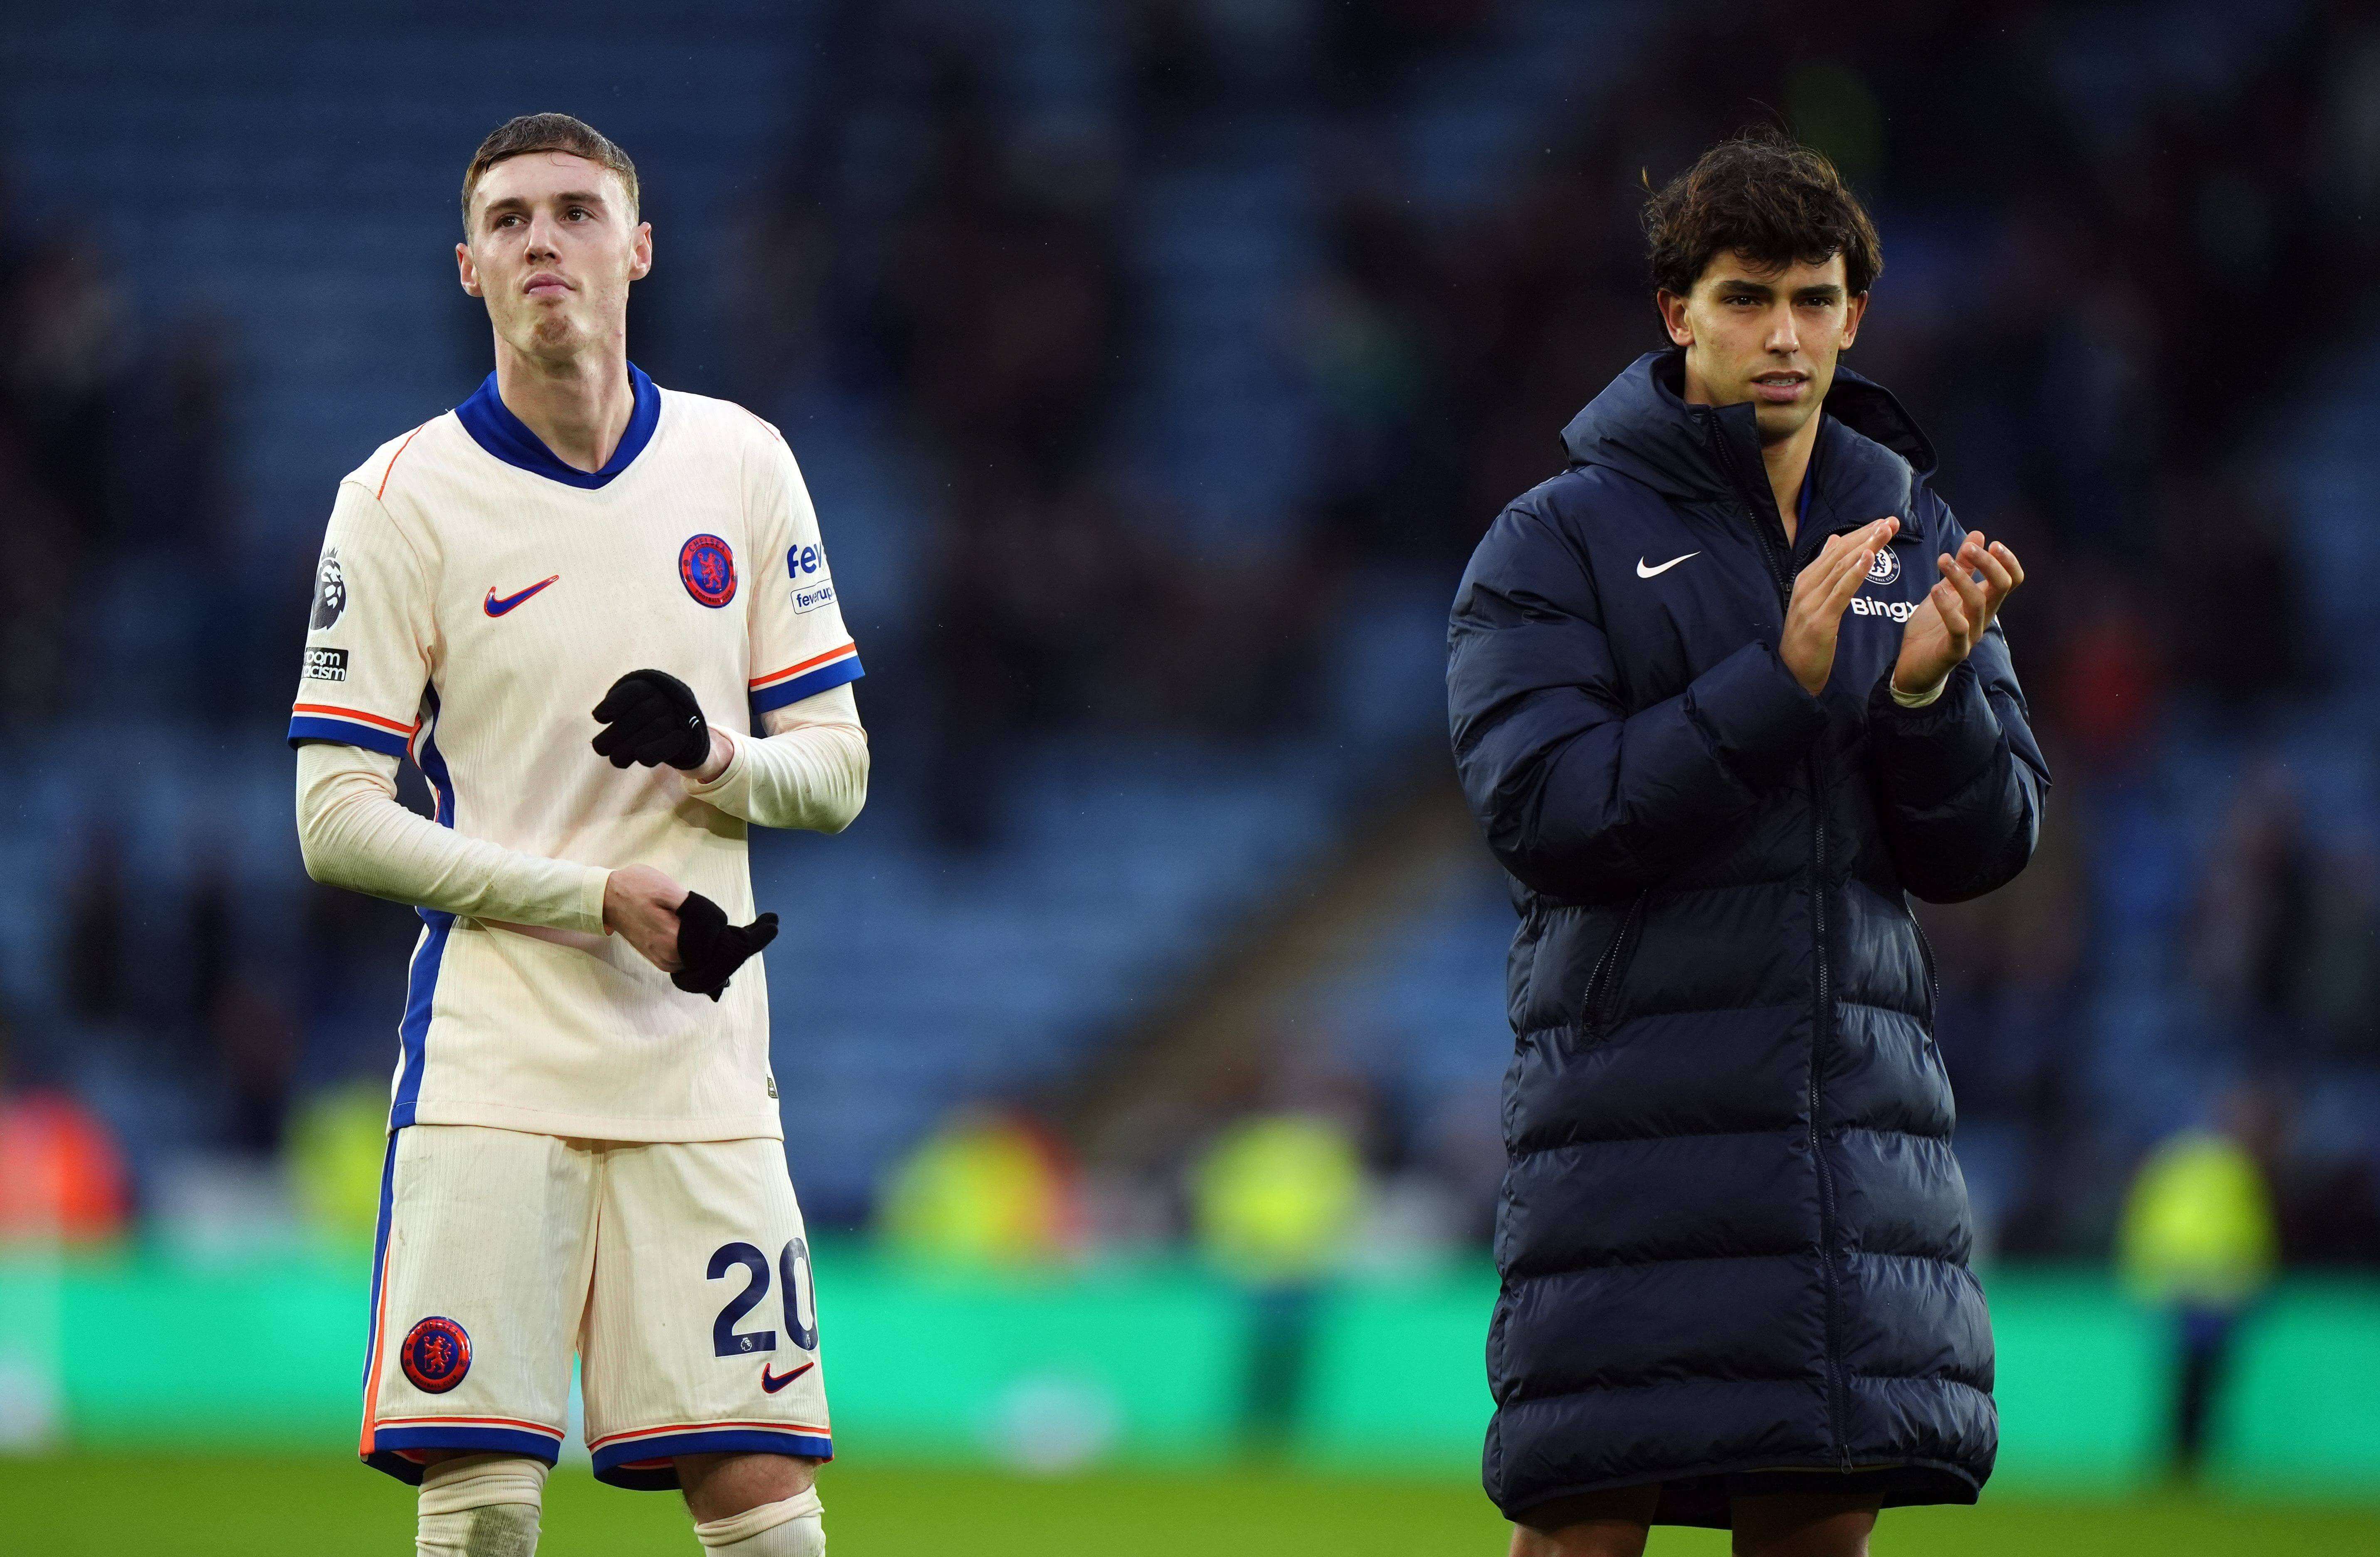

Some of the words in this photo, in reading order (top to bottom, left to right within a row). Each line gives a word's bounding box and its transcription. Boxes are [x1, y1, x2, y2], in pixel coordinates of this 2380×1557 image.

[305, 651, 340, 666] oom
[303, 665, 346, 681] acism
[706, 1236, 818, 1357] 20
